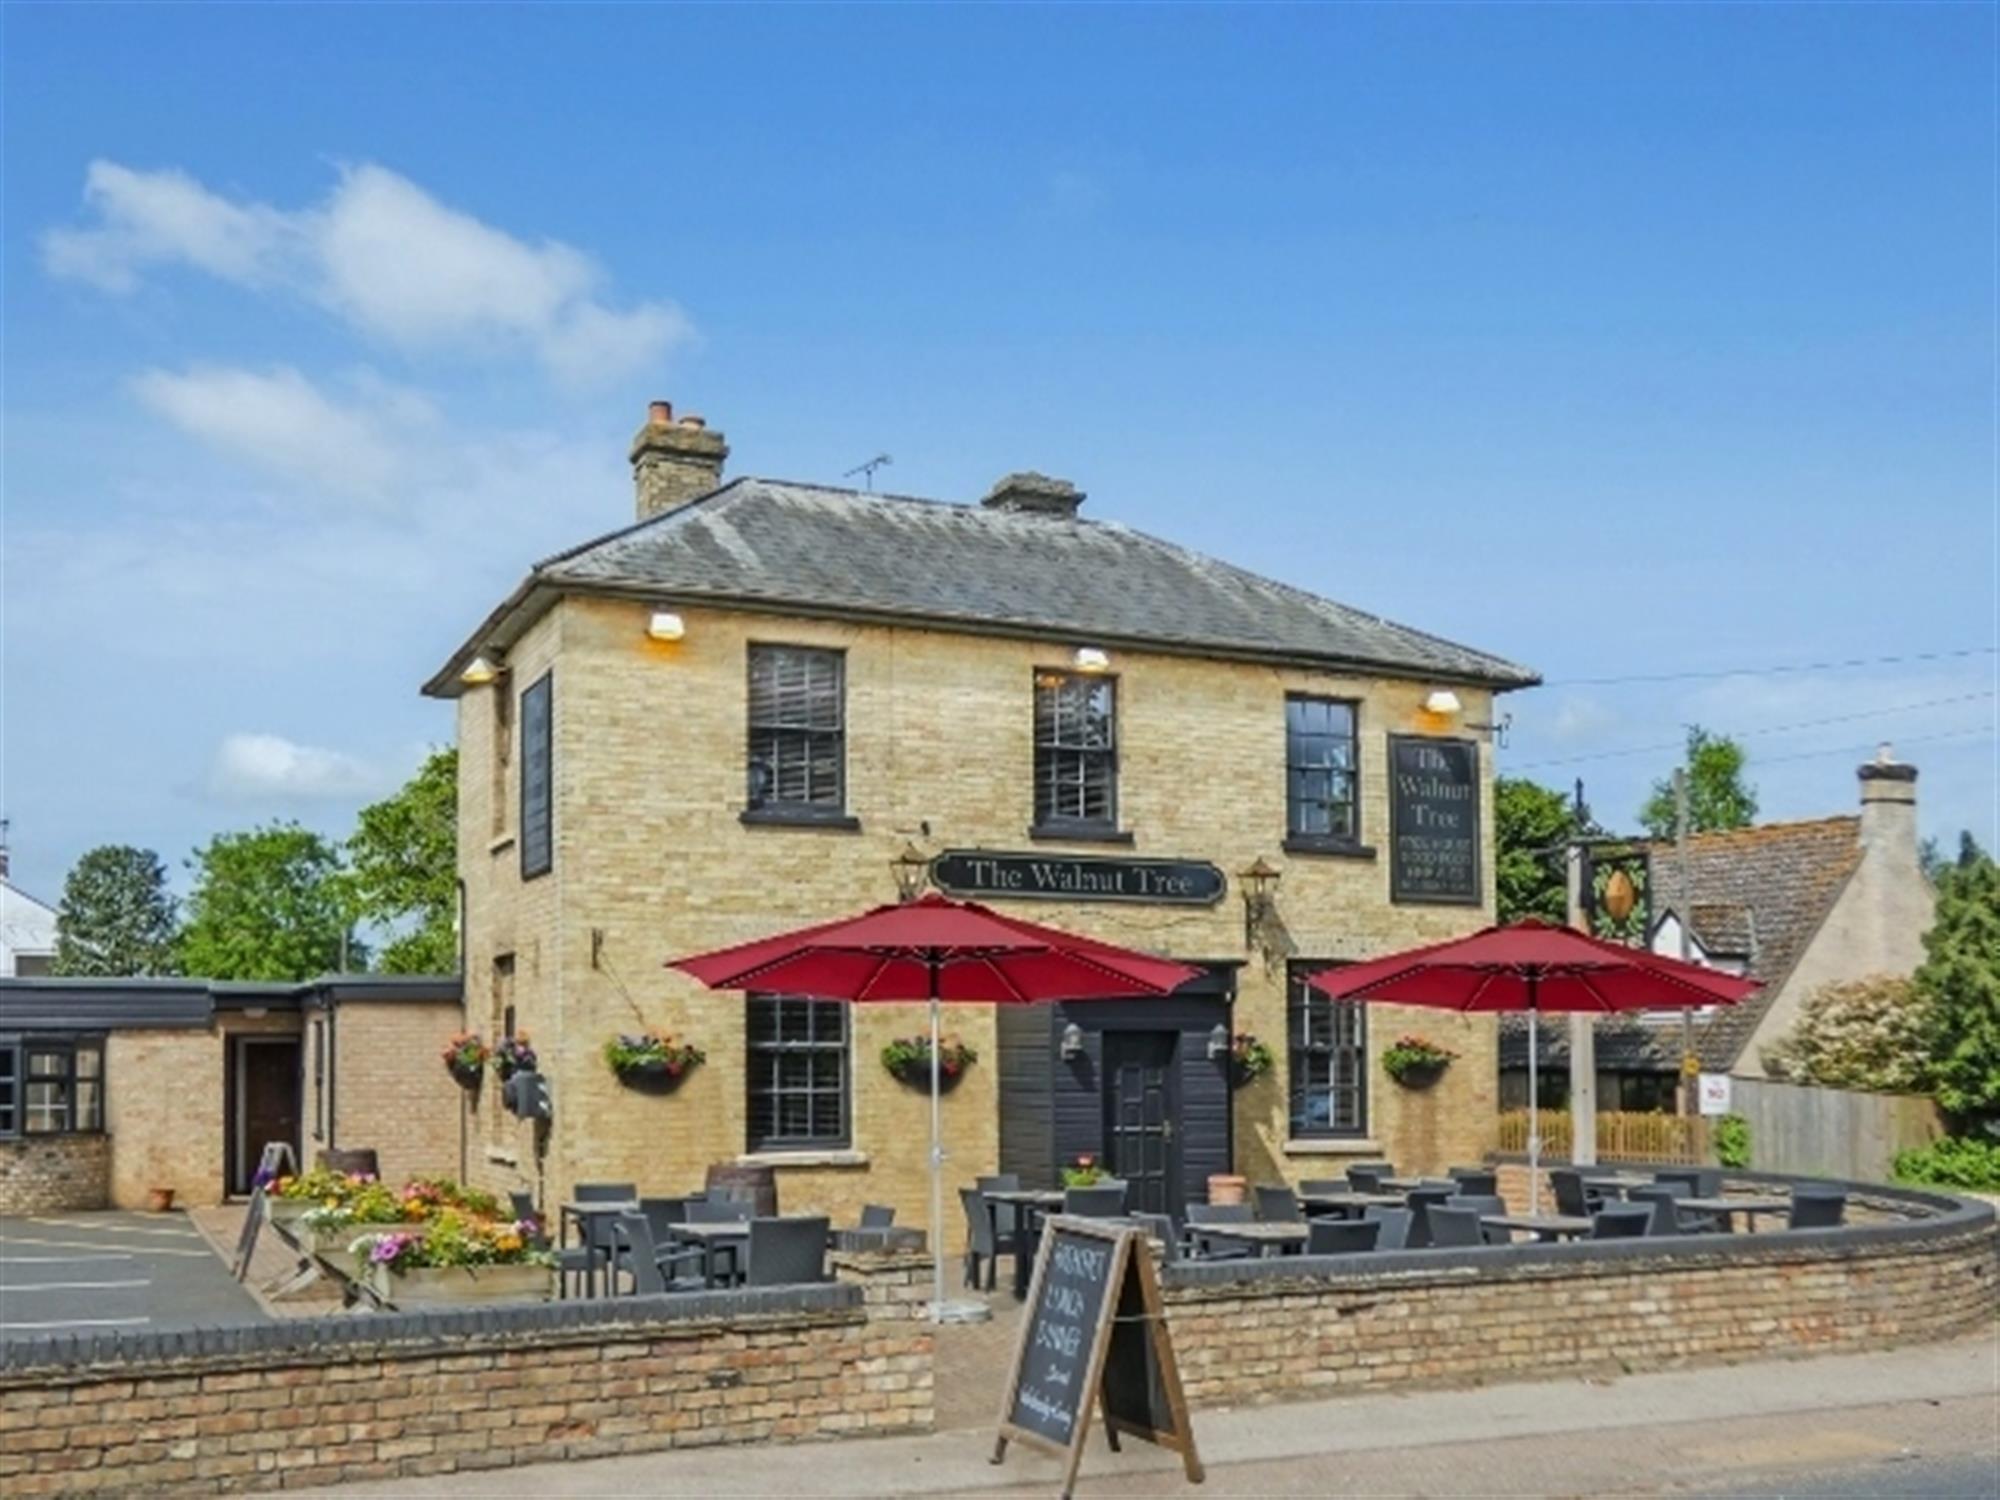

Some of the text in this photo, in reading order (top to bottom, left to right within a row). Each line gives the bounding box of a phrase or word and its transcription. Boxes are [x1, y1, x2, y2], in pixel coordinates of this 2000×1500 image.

[1398, 775, 1471, 800] Walnut
[1410, 803, 1460, 829] Tree
[966, 859, 1194, 895] The Walnut Tree
